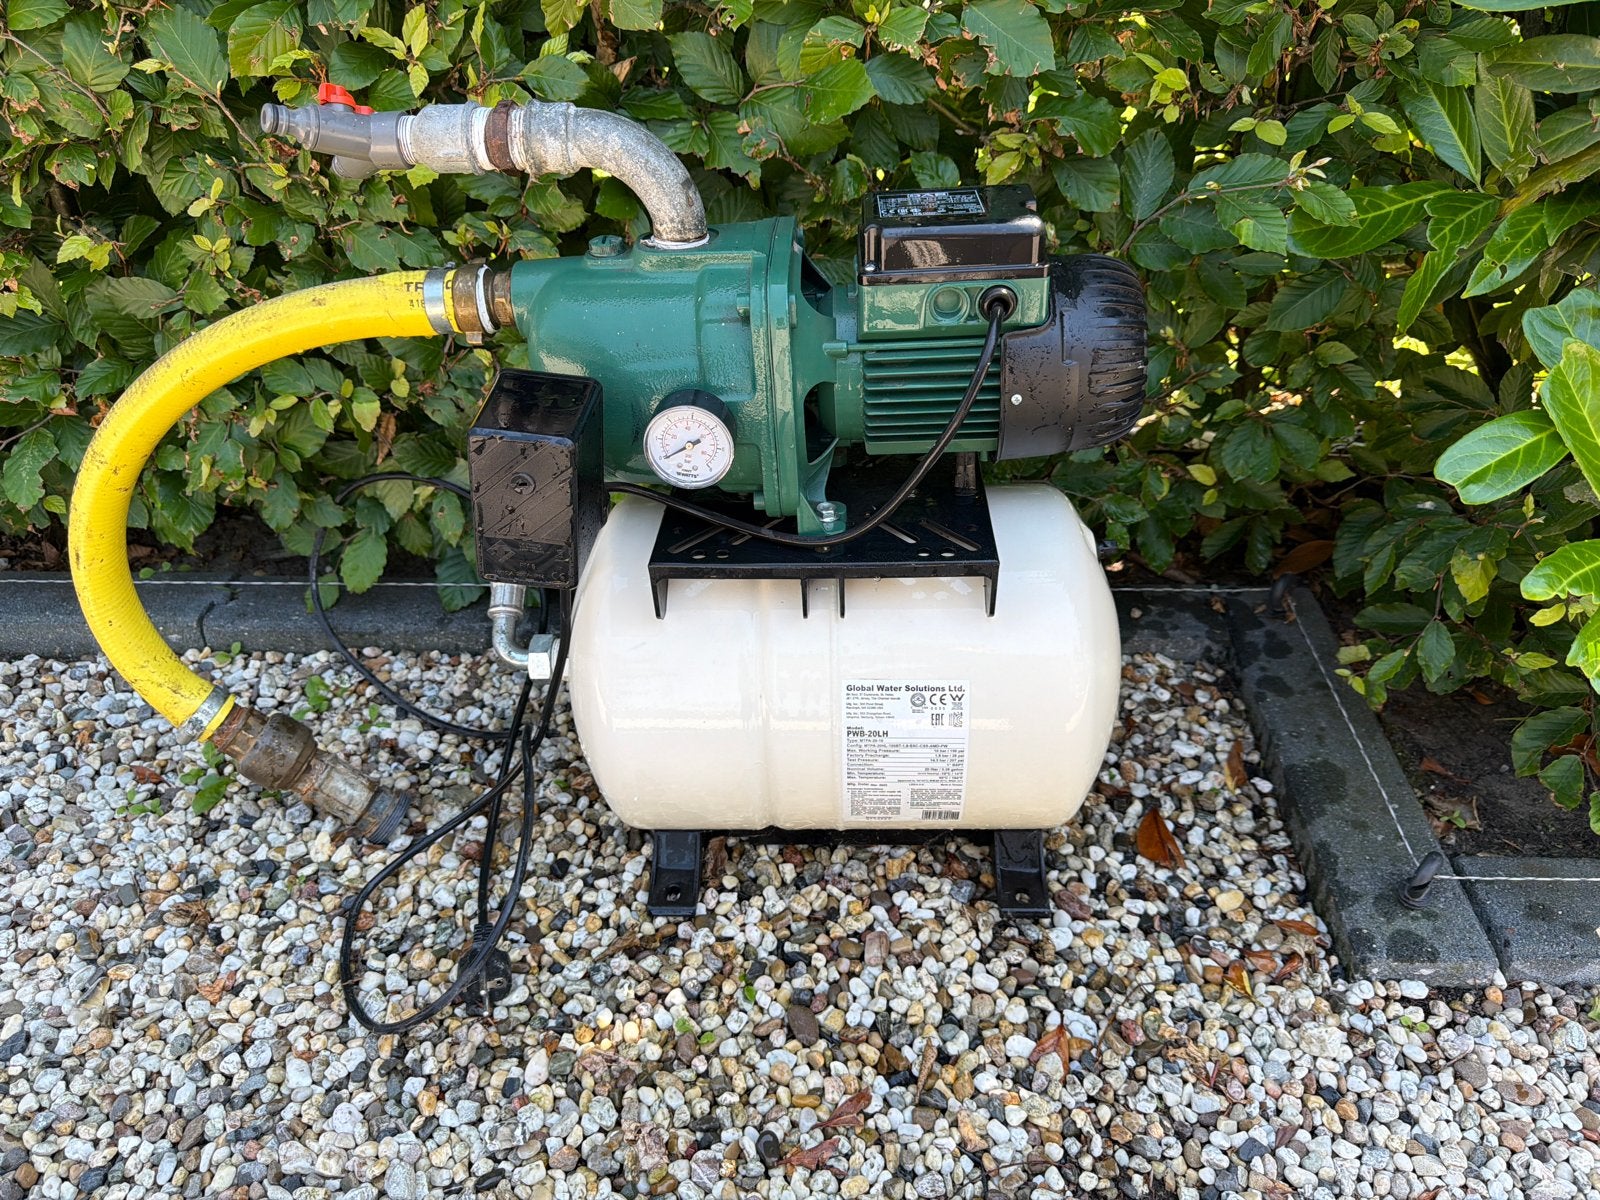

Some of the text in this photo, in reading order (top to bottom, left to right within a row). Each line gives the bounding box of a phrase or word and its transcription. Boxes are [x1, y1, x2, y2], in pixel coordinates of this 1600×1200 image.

[904, 684, 946, 692] Solutions
[948, 684, 965, 692] Ltd.
[846, 730, 889, 738] PWB-20LH
